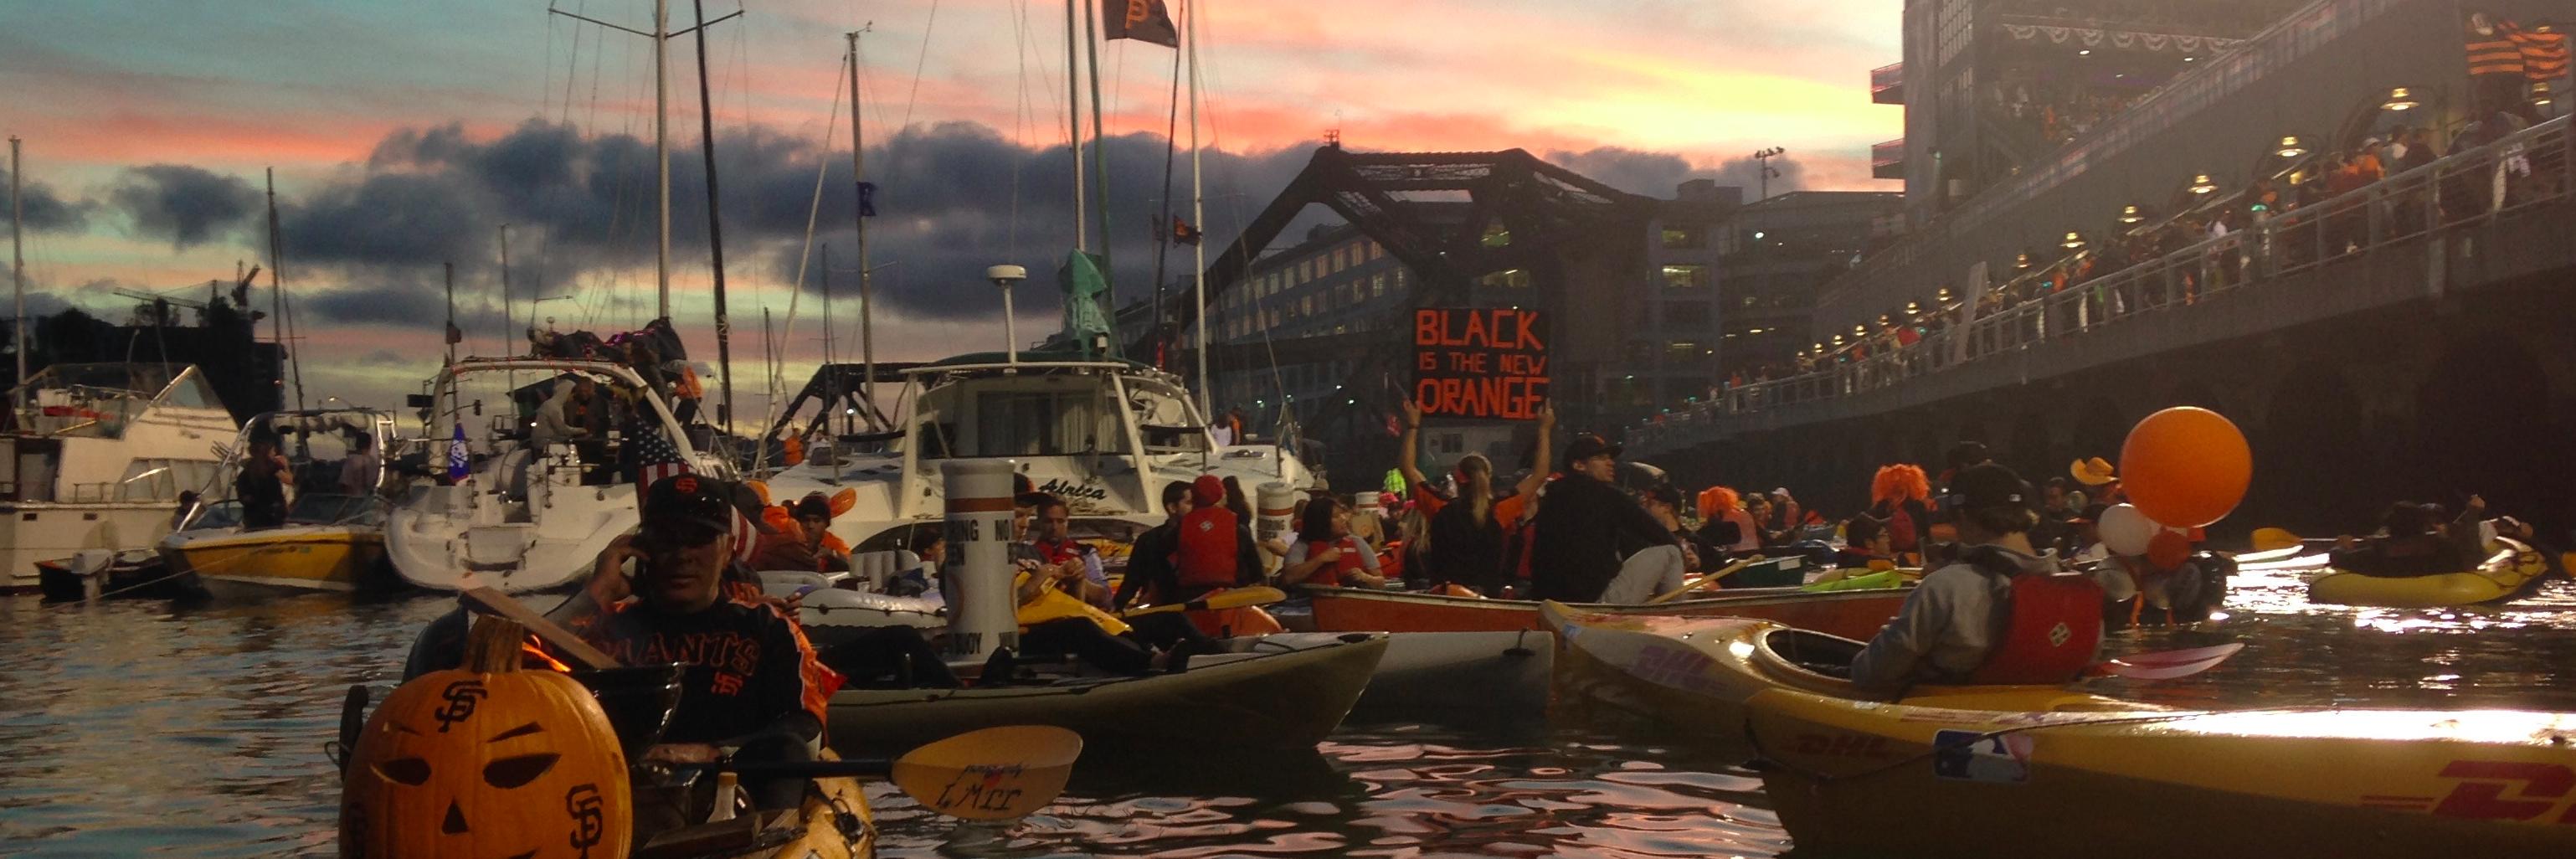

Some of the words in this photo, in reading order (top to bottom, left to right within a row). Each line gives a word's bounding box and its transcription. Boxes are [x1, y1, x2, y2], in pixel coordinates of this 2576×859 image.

[1416, 308, 1545, 351] BLACK
[1418, 351, 1437, 371] IS
[1447, 350, 1488, 373] THE
[1499, 353, 1547, 375] NEW
[1417, 376, 1551, 420] ORANGE
[434, 680, 488, 733] SF
[2430, 759, 2576, 824] D
